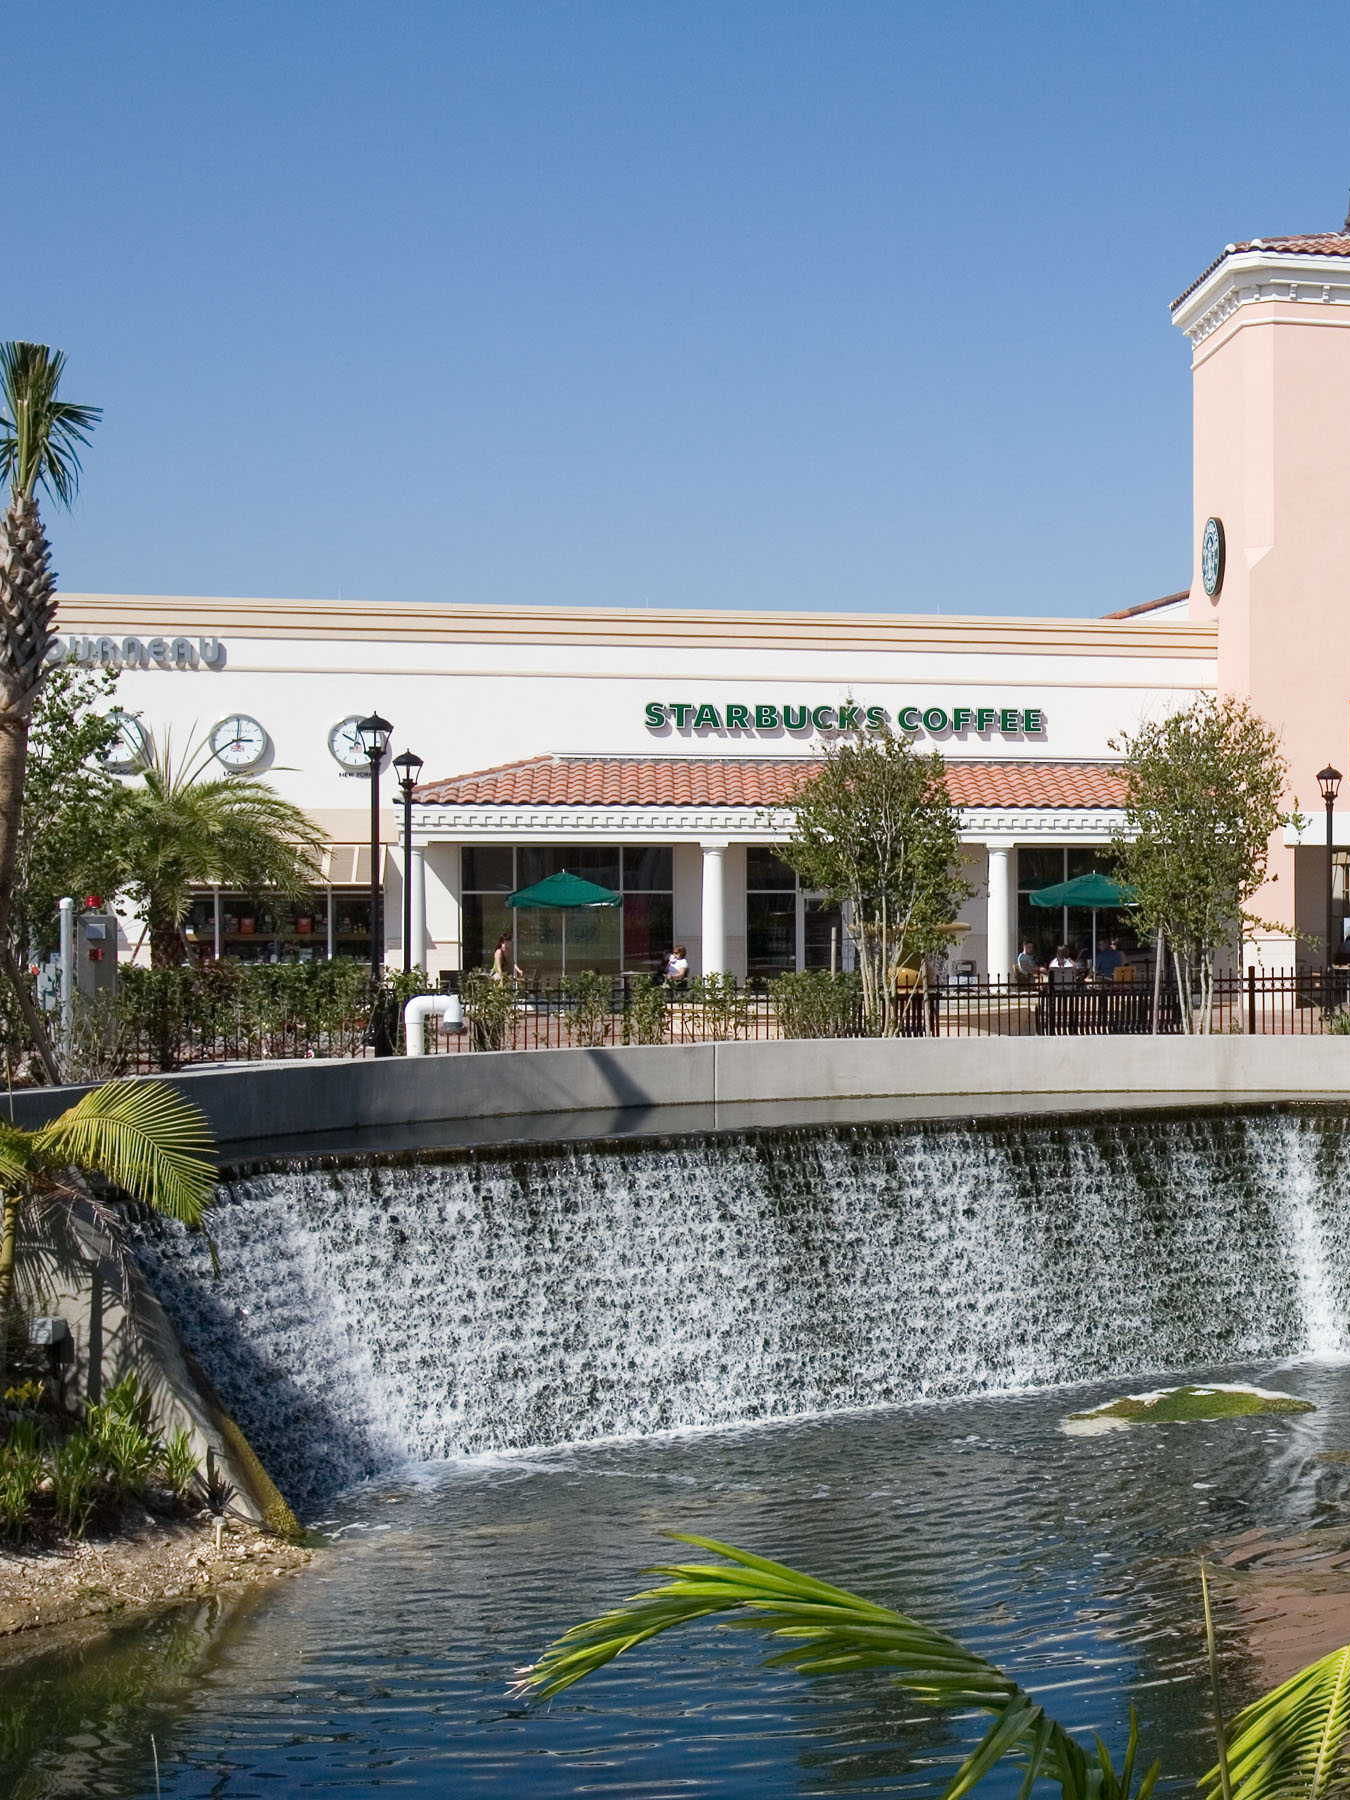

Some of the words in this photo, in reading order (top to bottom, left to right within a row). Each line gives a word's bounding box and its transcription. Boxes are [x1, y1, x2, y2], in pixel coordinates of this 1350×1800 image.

[45, 635, 220, 663] OURNEAU
[644, 702, 886, 732] STARBUCKS
[897, 706, 1043, 734] COFFEE
